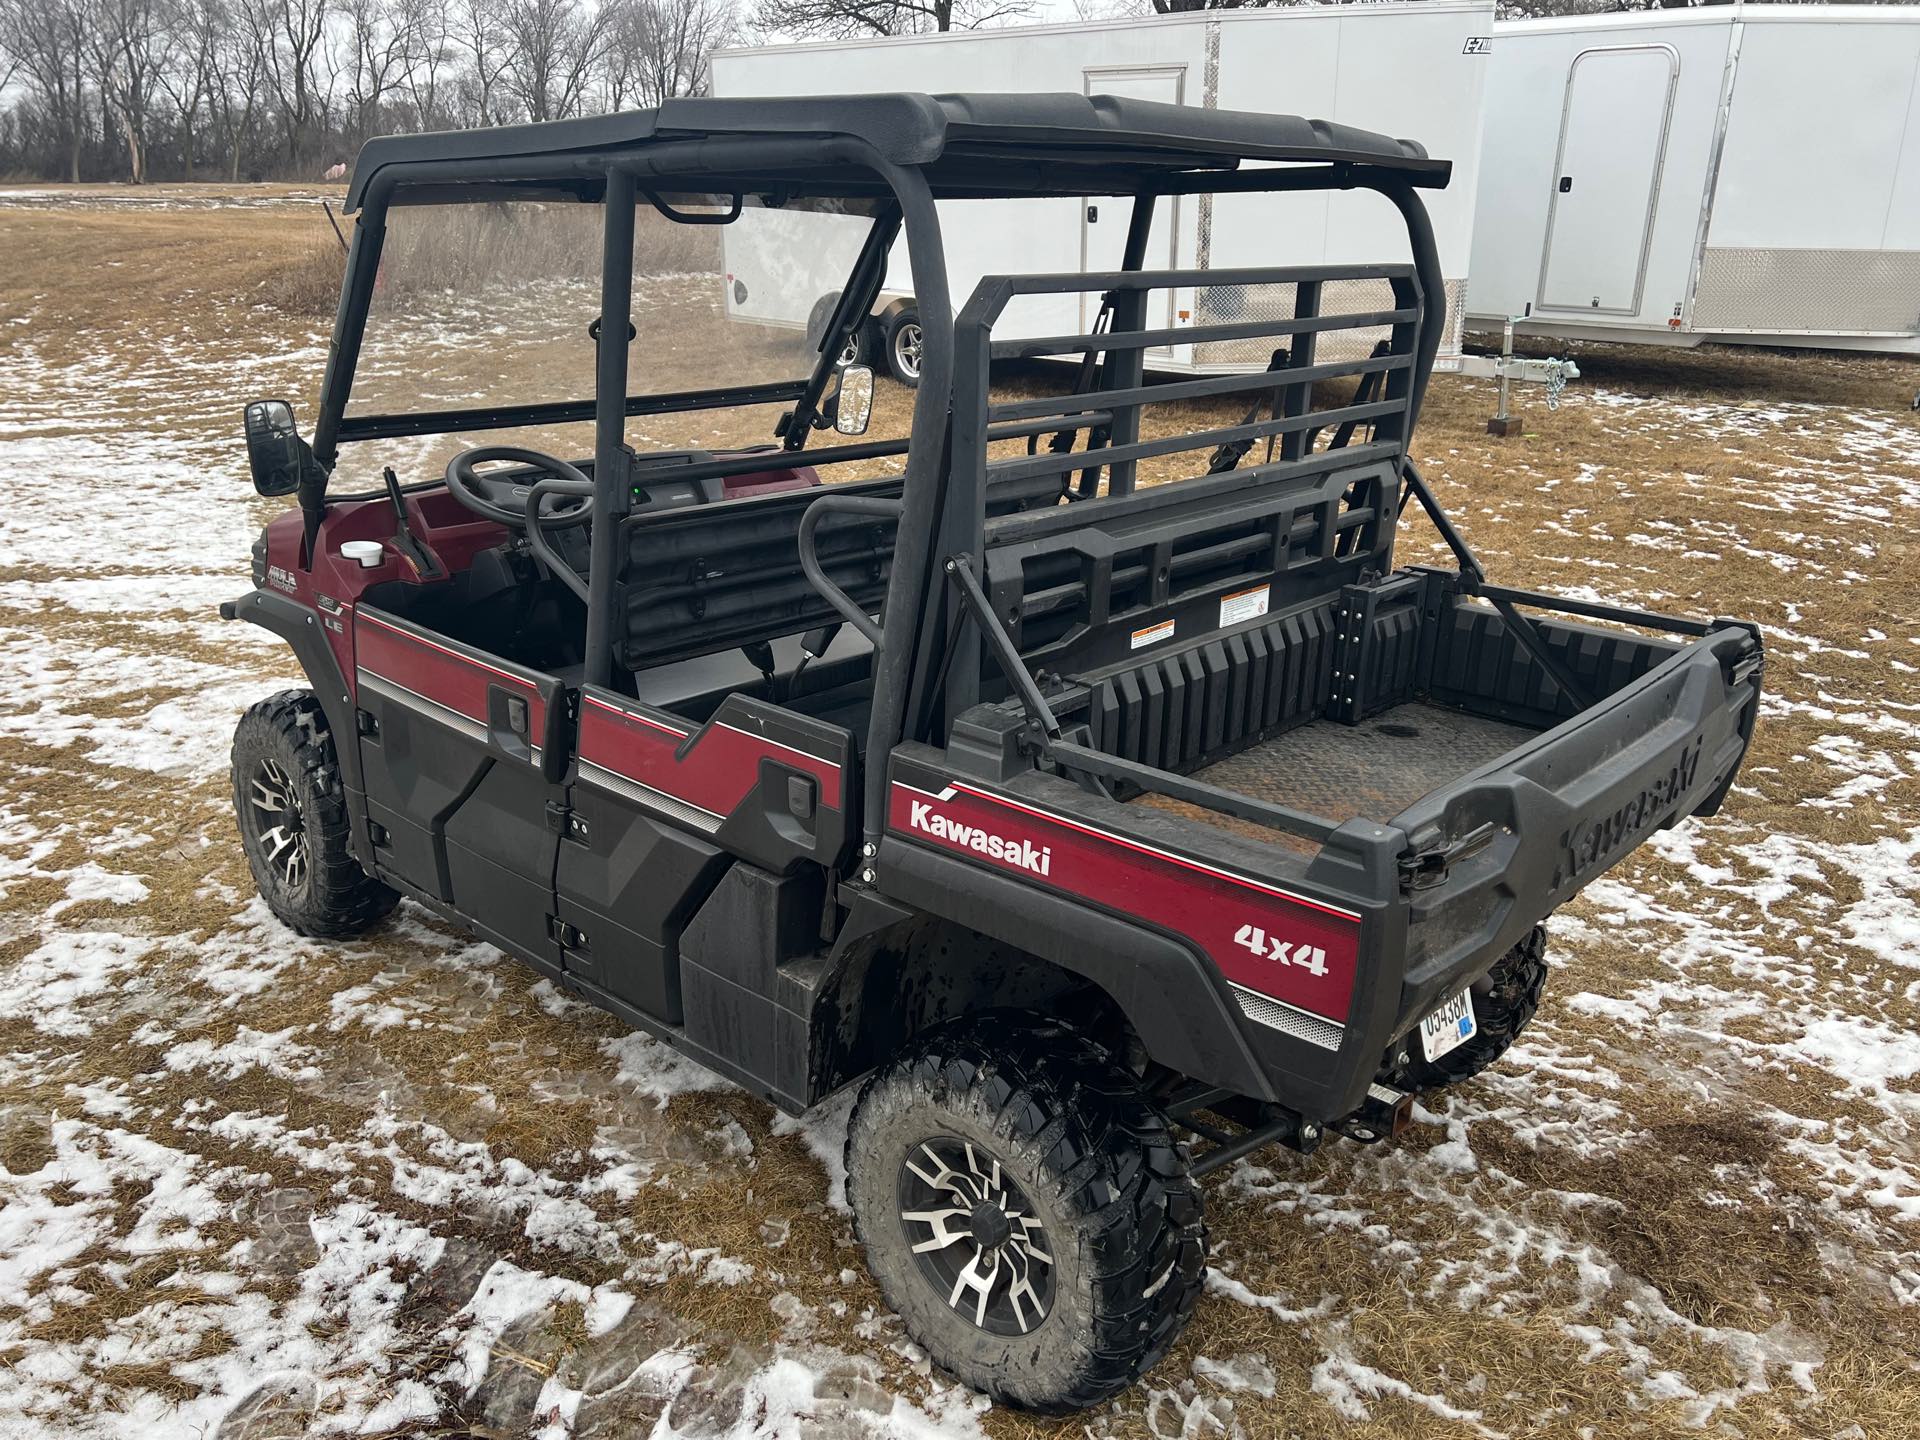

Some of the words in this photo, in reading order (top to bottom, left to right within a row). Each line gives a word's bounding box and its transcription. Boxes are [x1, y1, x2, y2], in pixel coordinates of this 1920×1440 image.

[325, 617, 343, 634] LE
[910, 800, 1051, 877] Kawasaki
[1234, 924, 1329, 977] 4x4
